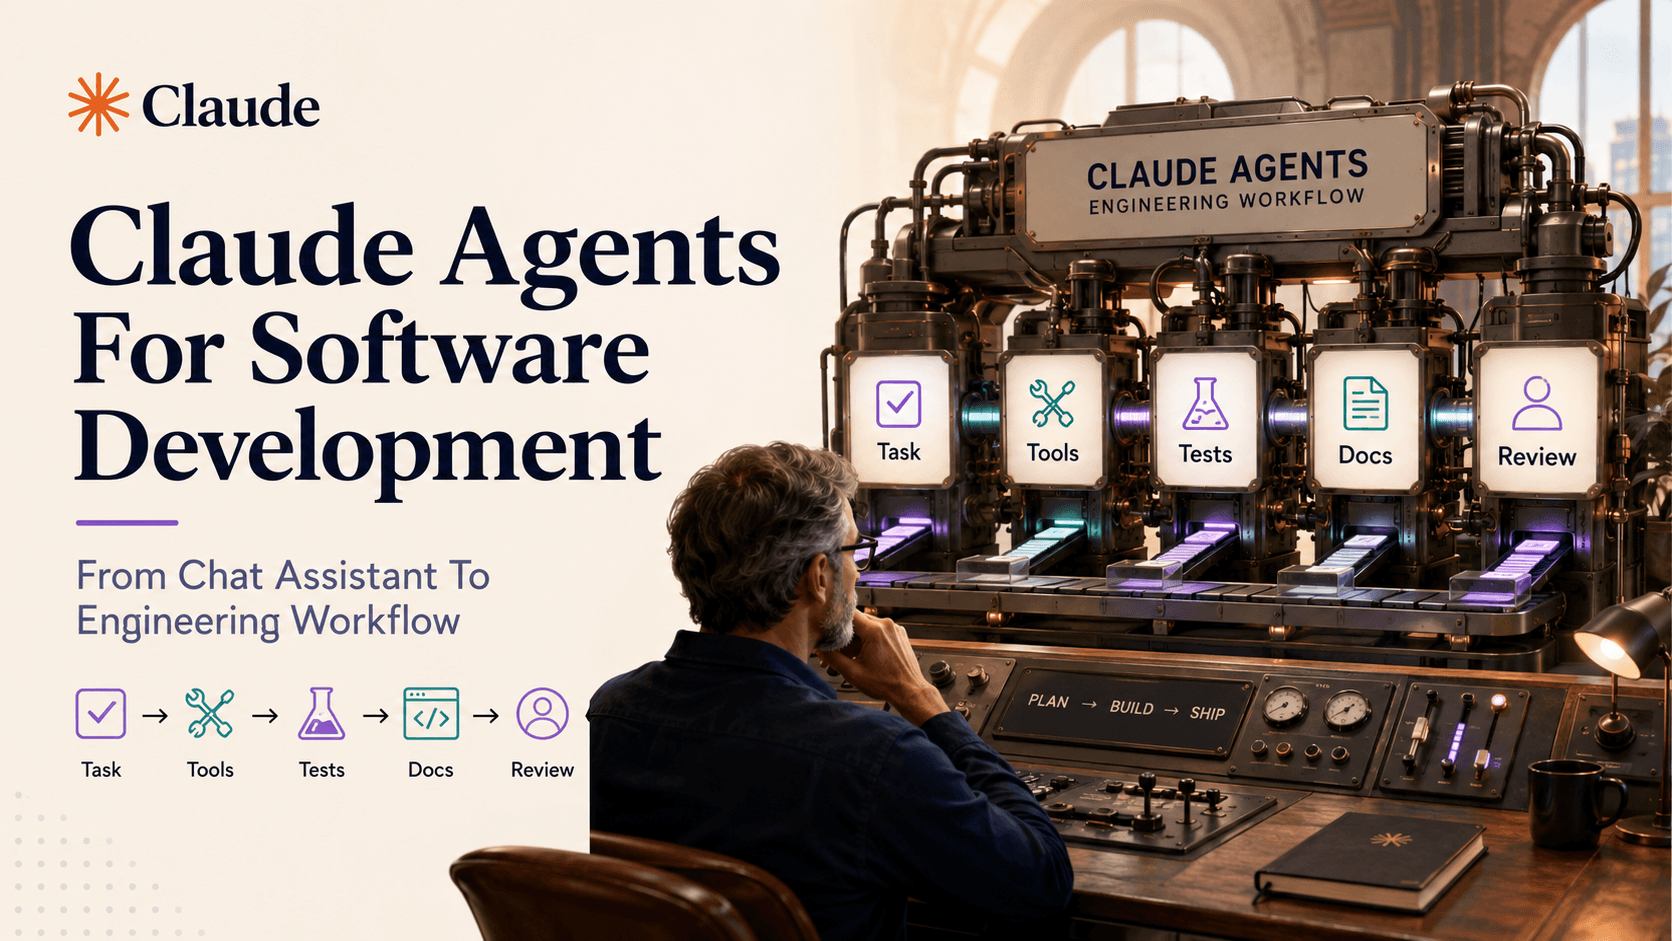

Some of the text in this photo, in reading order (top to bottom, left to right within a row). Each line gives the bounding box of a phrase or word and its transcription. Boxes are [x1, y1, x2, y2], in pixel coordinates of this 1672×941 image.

[1087, 148, 1368, 191] CLAUDE AGENTS
[1089, 187, 1365, 215] ENGINEERING WORKFLOW
[876, 441, 921, 461] Task
[1026, 442, 1079, 462] Tools
[1178, 443, 1233, 464] Tests
[1339, 444, 1393, 465] Docs
[1498, 445, 1577, 467] Review
[1028, 693, 1226, 721] PLAN BUILD SHIP
